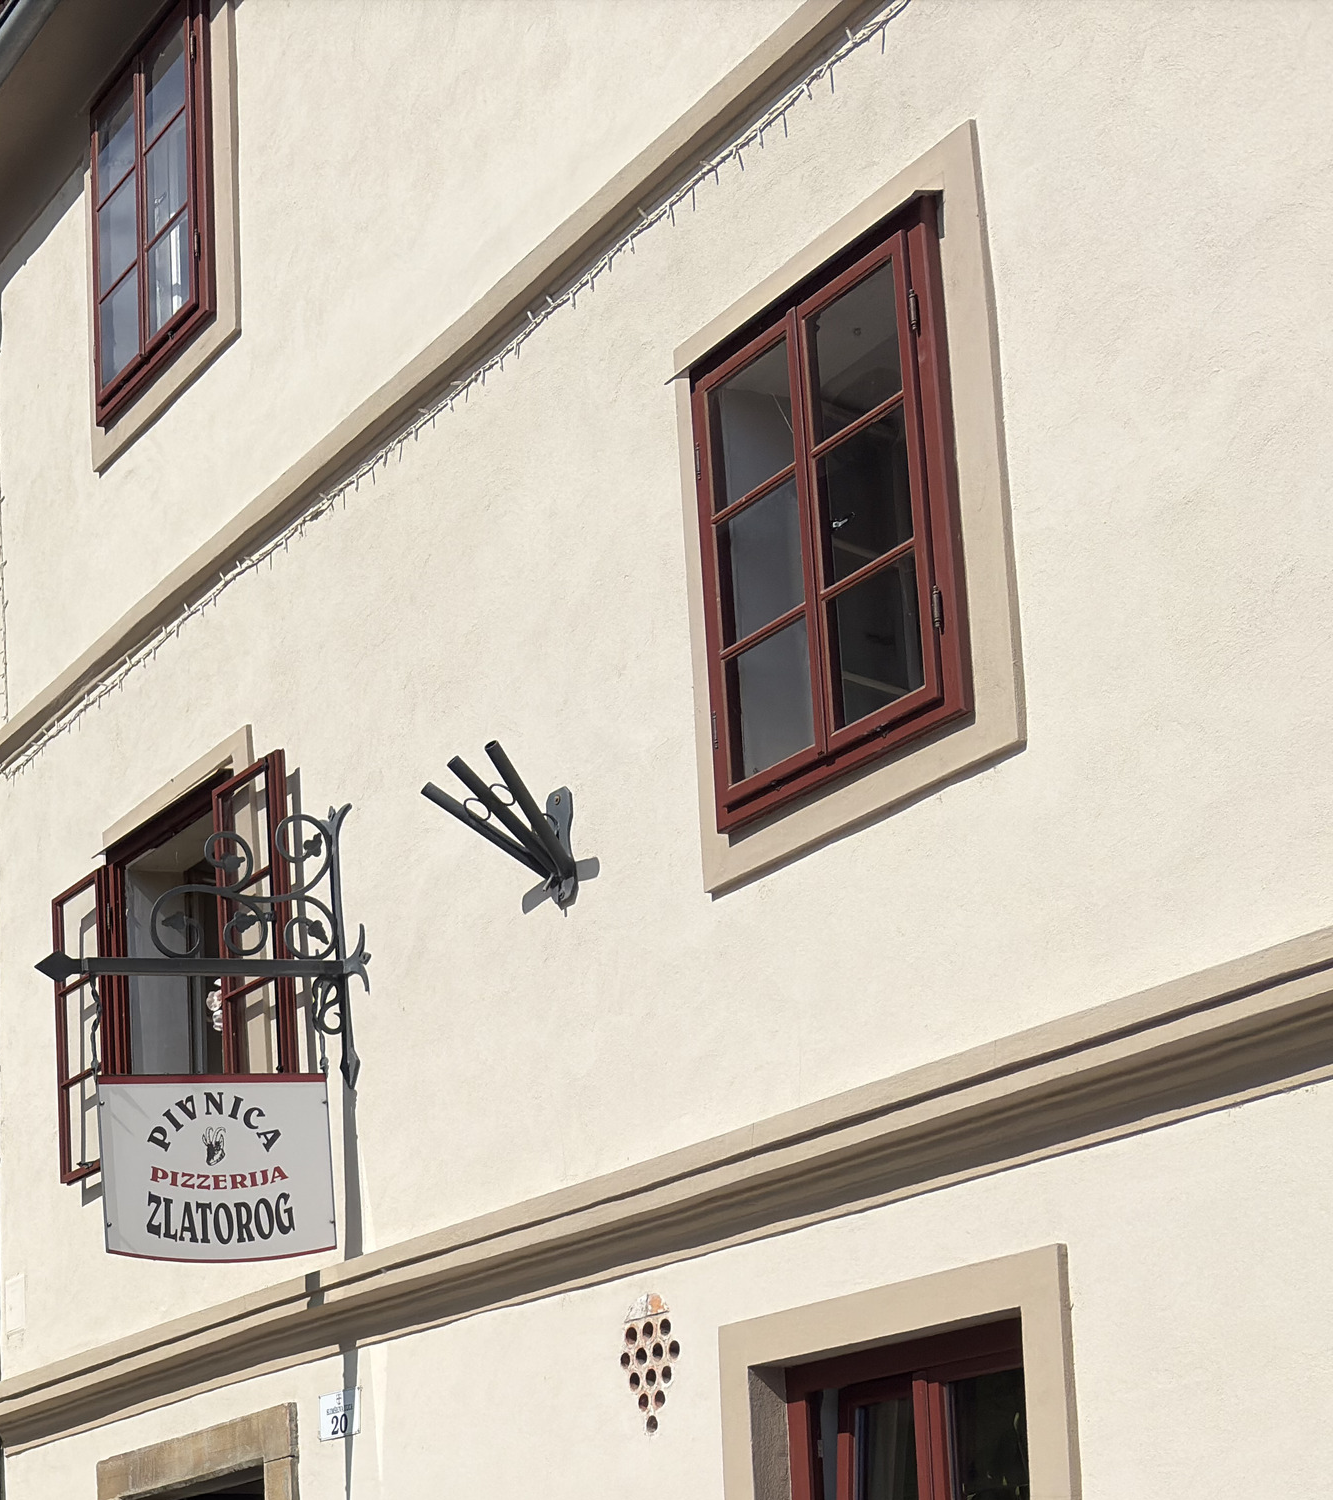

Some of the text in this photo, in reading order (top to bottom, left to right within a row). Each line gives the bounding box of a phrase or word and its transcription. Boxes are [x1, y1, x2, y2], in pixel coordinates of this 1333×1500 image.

[147, 1092, 282, 1152] PIVNICA
[149, 1166, 289, 1190] PIZZERIJA
[146, 1191, 295, 1244] ZLATOROG
[331, 1413, 348, 1435] 20
